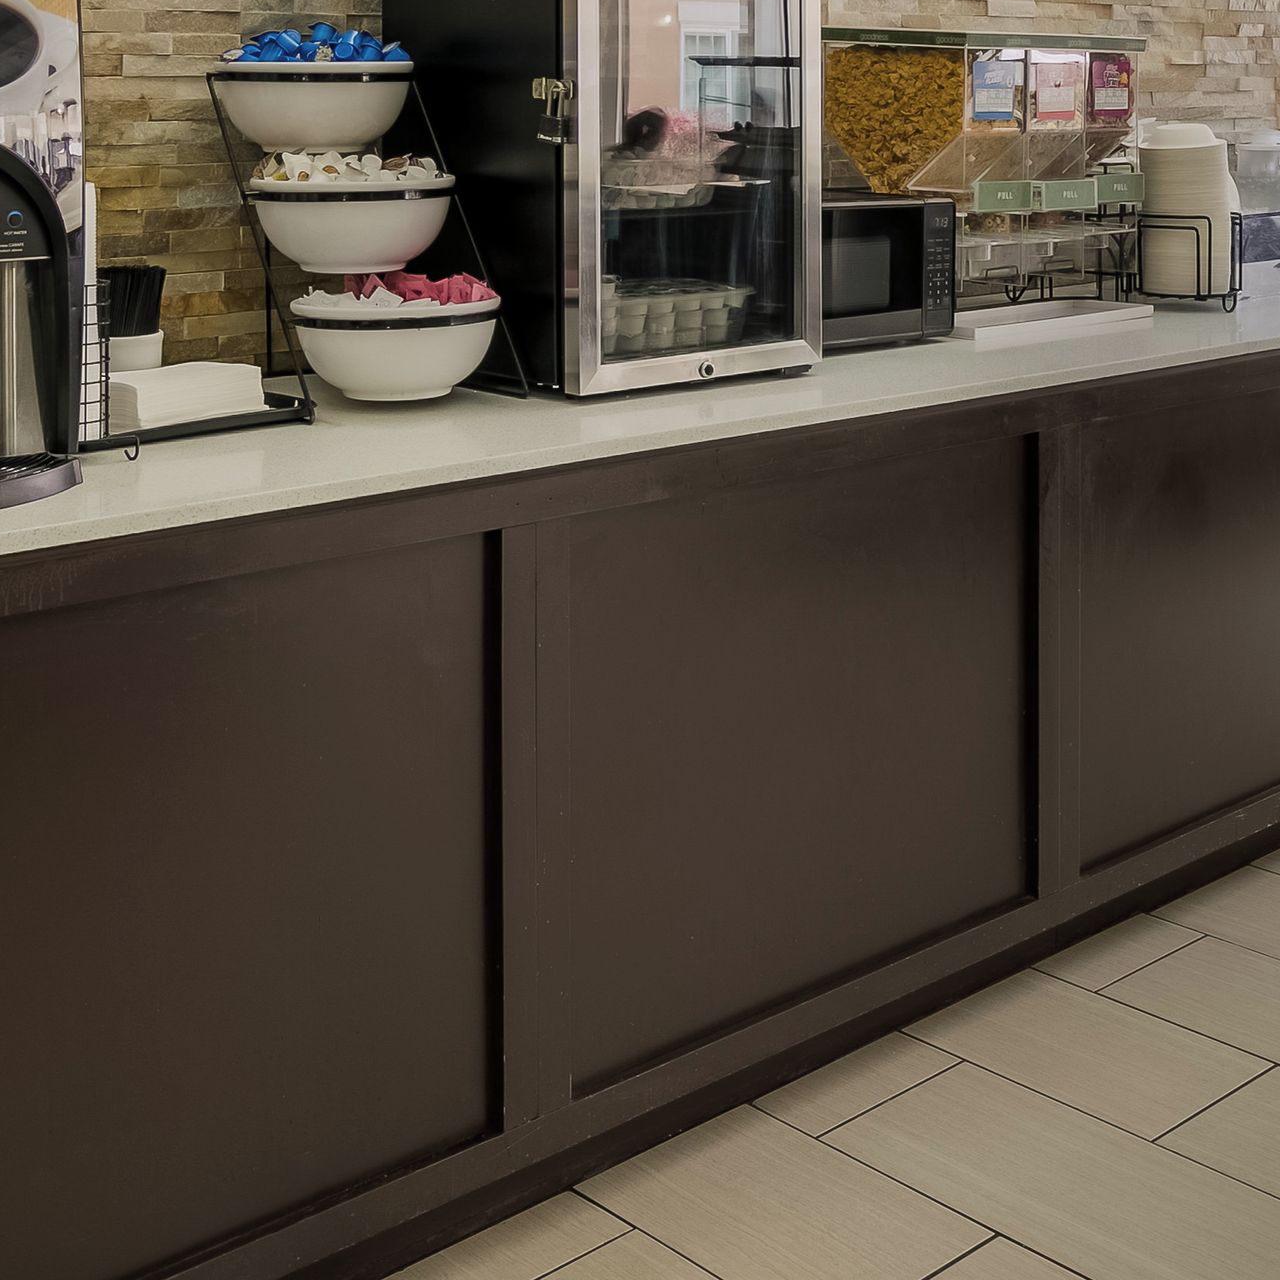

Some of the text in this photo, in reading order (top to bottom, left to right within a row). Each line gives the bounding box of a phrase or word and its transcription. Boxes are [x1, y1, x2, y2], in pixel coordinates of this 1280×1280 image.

[1113, 183, 1128, 191] PULL
[997, 191, 1013, 200] PULL
[1063, 190, 1078, 199] PULL
